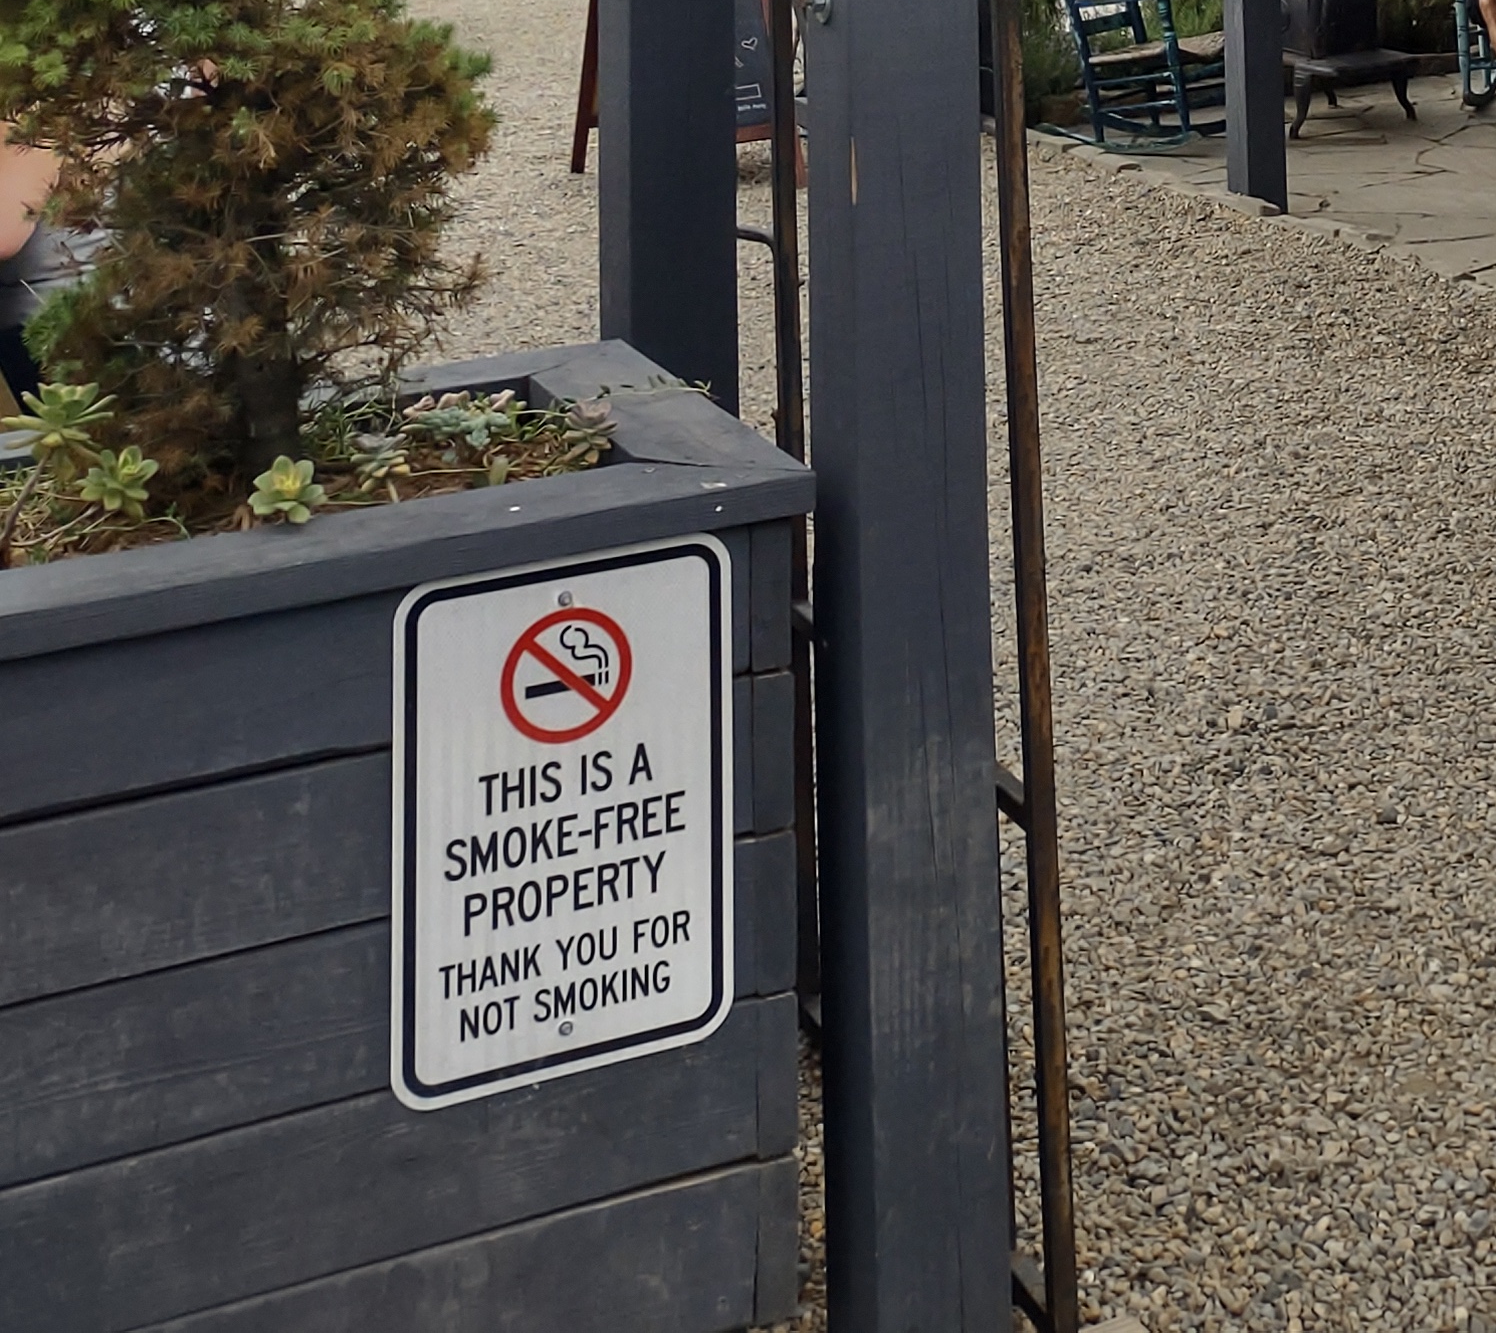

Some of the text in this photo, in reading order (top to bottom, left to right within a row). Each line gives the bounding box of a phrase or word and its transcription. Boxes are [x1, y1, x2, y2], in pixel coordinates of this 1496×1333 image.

[479, 743, 653, 816] THIS IS A
[444, 790, 687, 882] SMOKE-FREE
[463, 851, 666, 937] PROPERTY
[439, 909, 691, 1000] THANK YOU FOR
[460, 960, 672, 1042] NOT SMOKING
